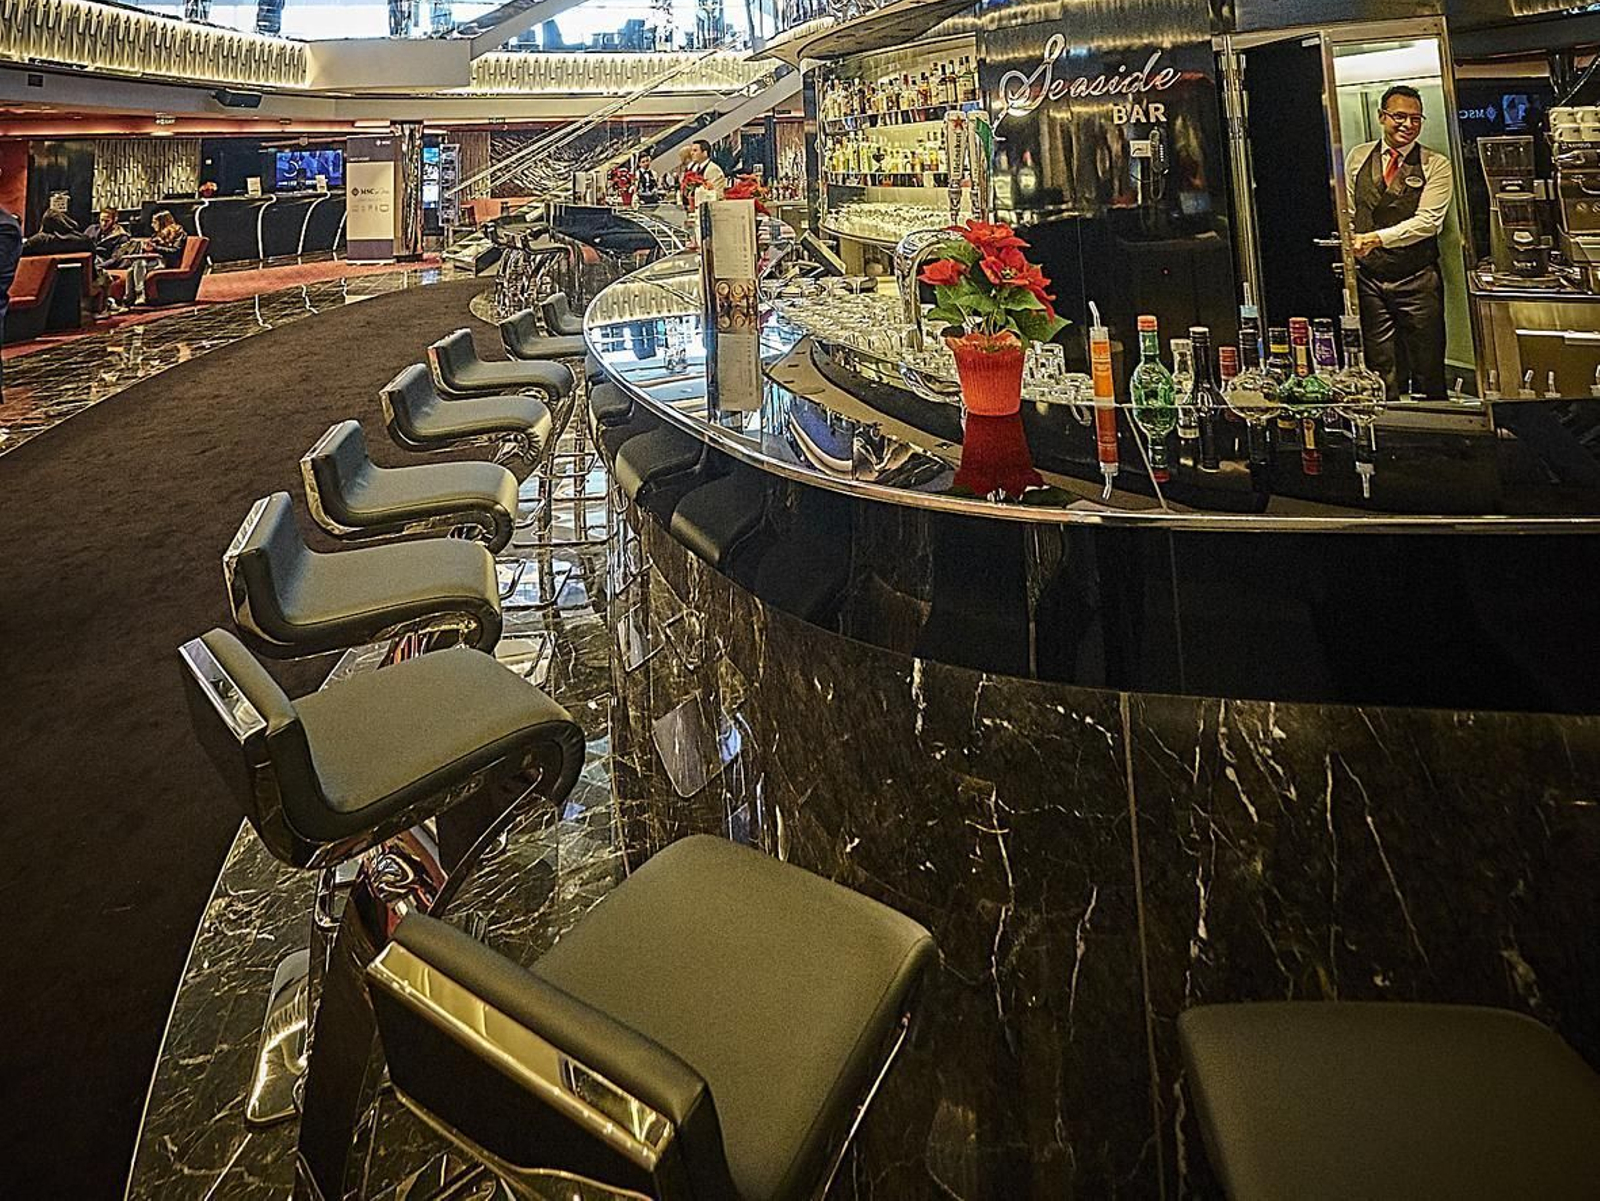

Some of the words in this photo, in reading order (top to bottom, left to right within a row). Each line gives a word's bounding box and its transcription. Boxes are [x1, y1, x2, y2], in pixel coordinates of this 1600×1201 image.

[992, 32, 1182, 141] Seaside
[1113, 102, 1168, 125] BAR
[953, 132, 962, 174] Heineken
